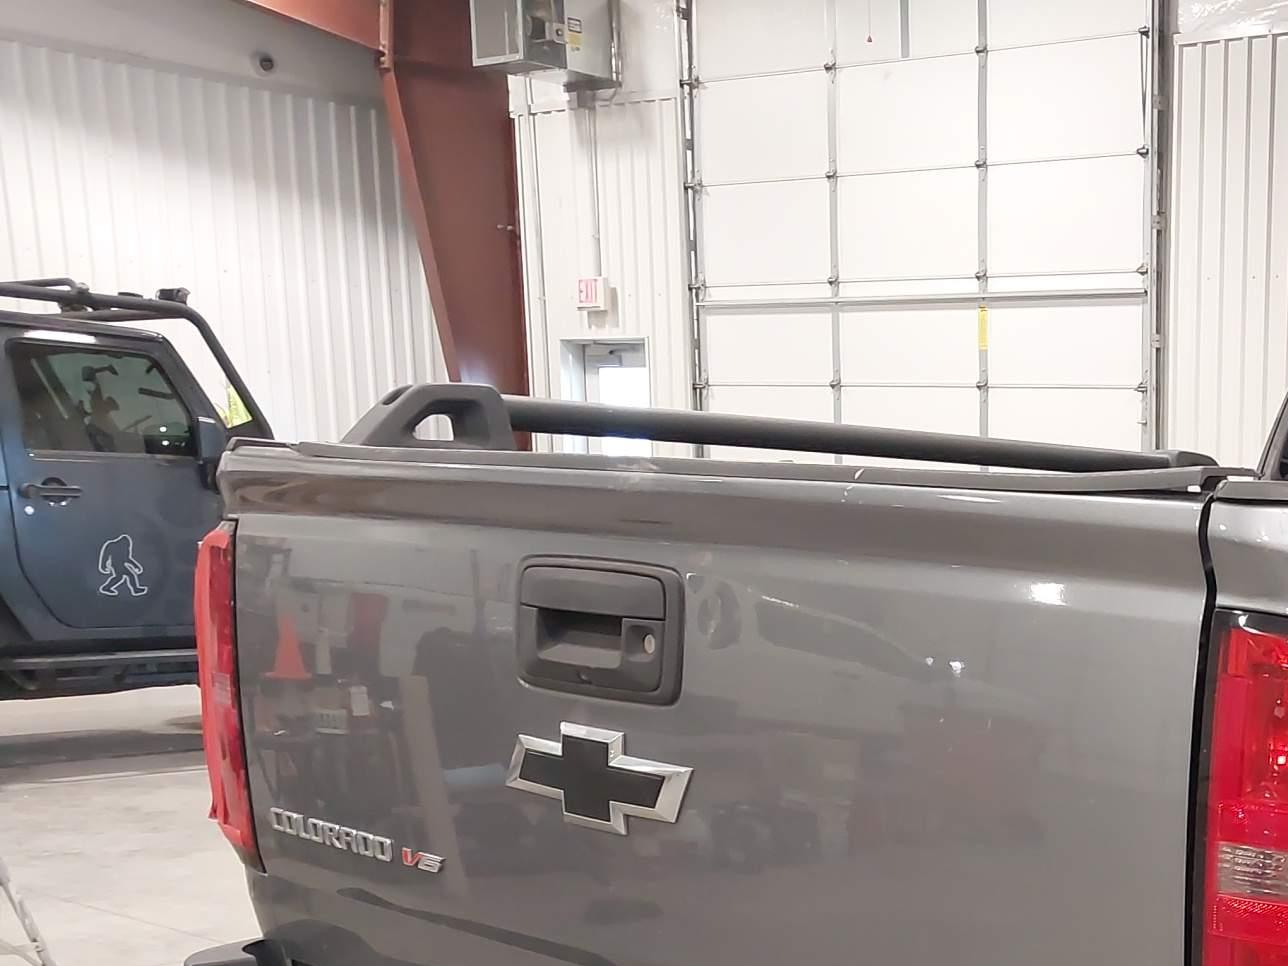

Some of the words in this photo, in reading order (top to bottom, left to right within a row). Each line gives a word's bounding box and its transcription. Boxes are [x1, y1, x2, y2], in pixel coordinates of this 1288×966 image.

[578, 278, 599, 304] EXIT
[269, 806, 394, 863] COLORADO
[401, 846, 447, 874] V6
